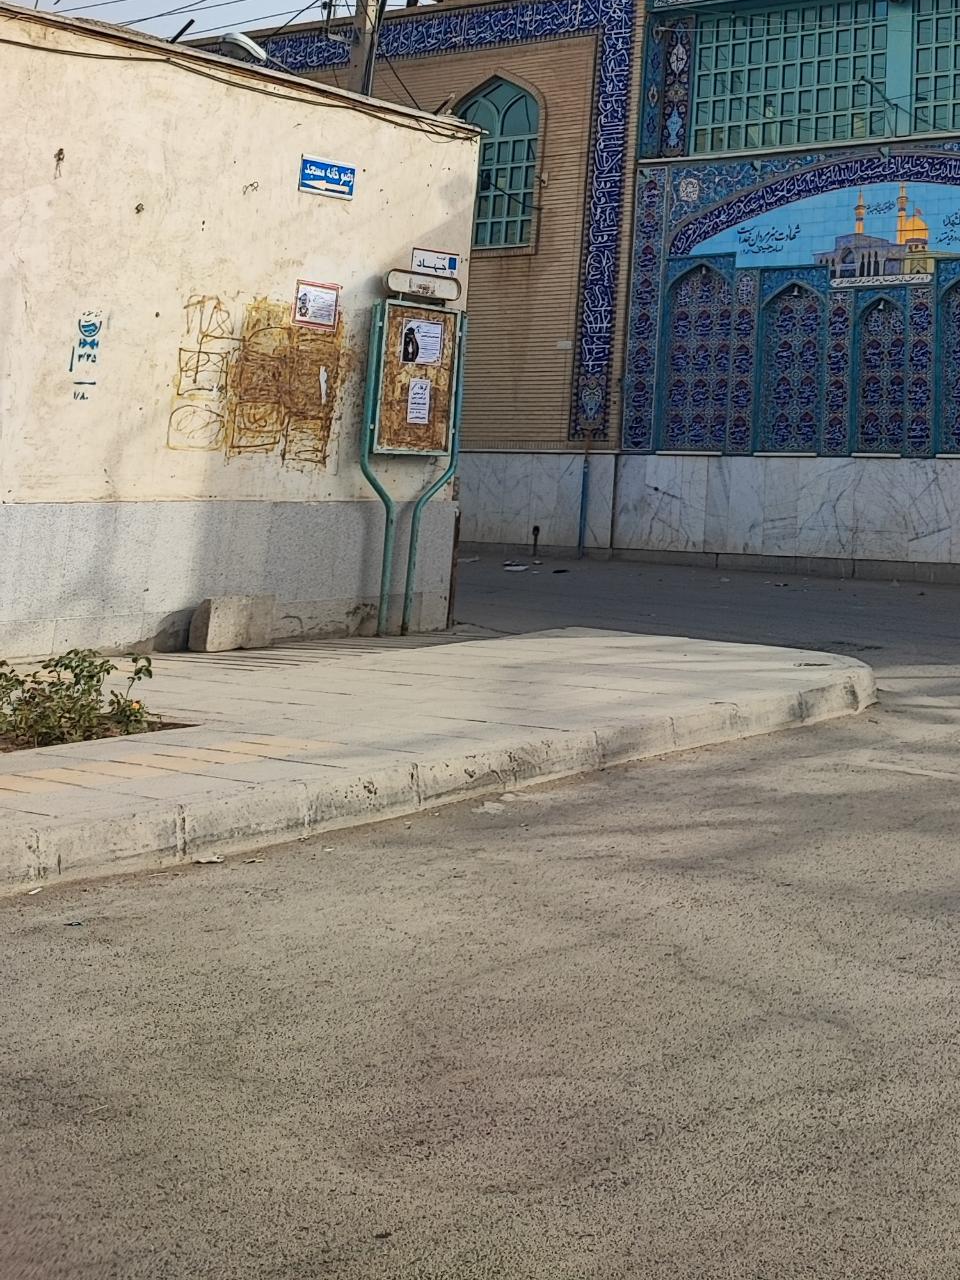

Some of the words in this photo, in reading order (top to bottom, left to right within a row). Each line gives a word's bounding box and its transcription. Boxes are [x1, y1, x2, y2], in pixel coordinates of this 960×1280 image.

[304, 163, 326, 179] مسجد
[326, 166, 340, 180] خانه
[340, 169, 354, 187] وضو
[416, 258, 447, 274] جهاد
